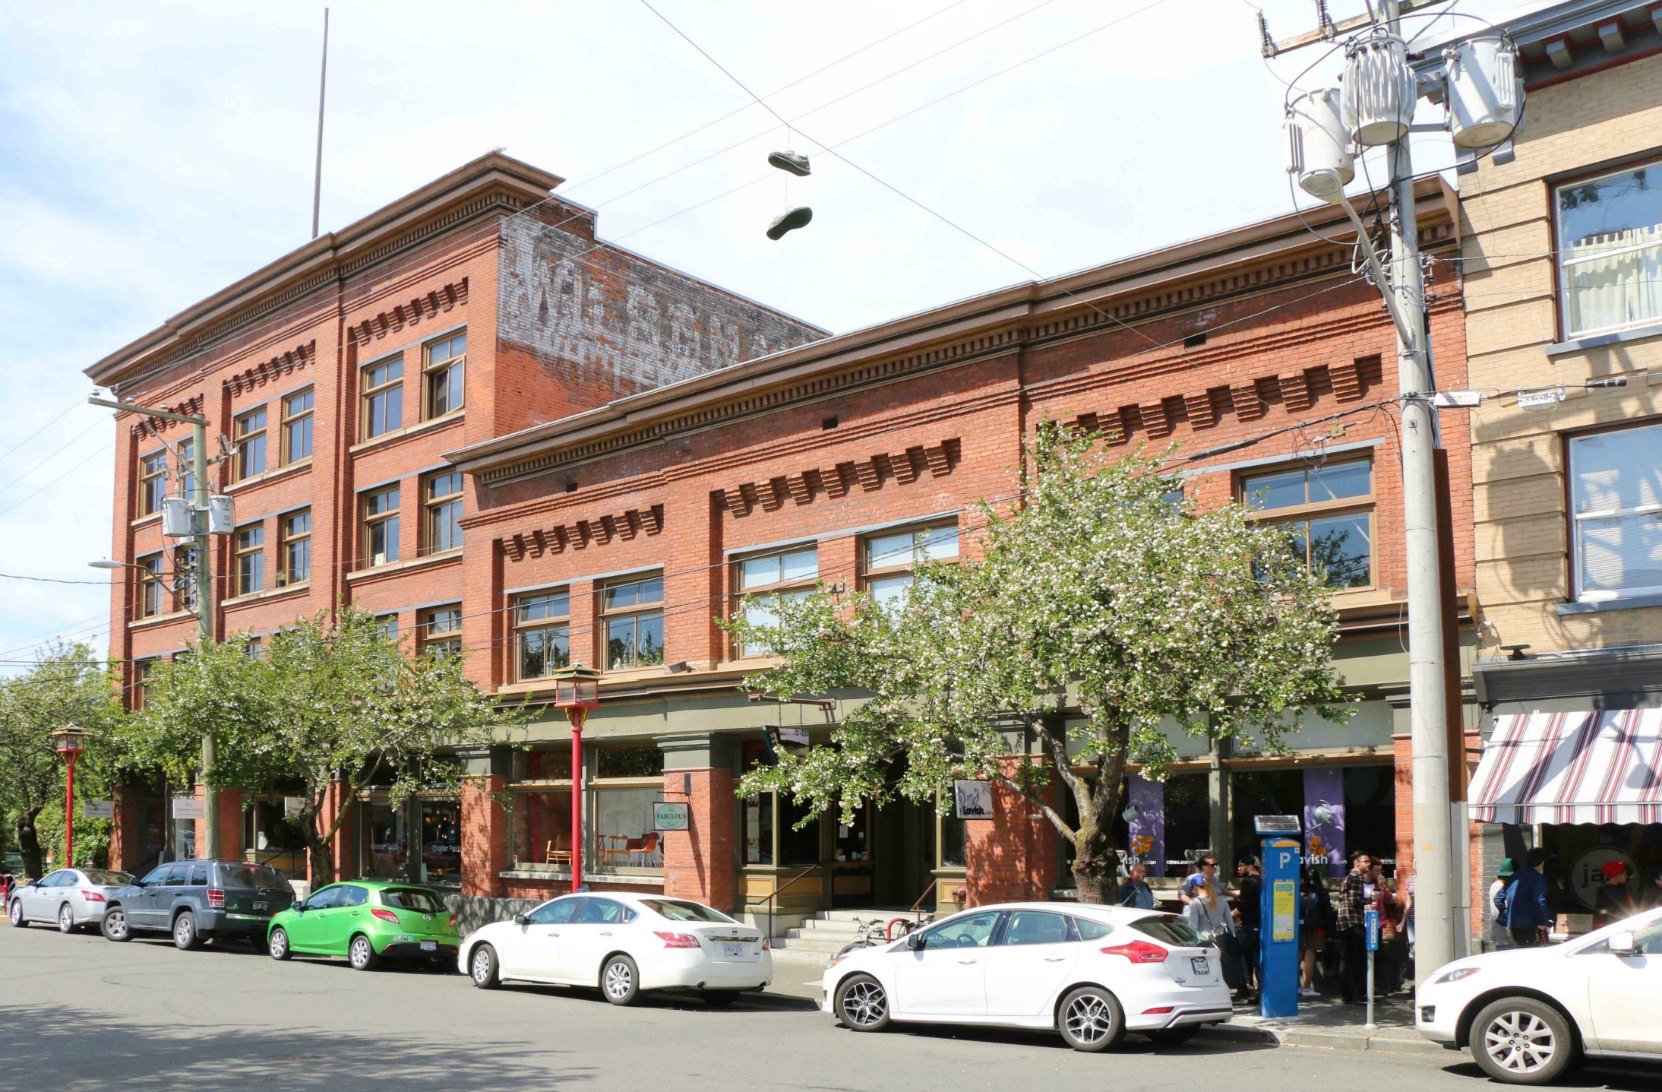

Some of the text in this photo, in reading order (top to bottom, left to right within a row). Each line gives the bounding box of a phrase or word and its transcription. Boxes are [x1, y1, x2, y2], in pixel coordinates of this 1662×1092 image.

[1279, 852, 1291, 869] P
[1299, 852, 1328, 865] avish
[1581, 863, 1605, 888] ja
